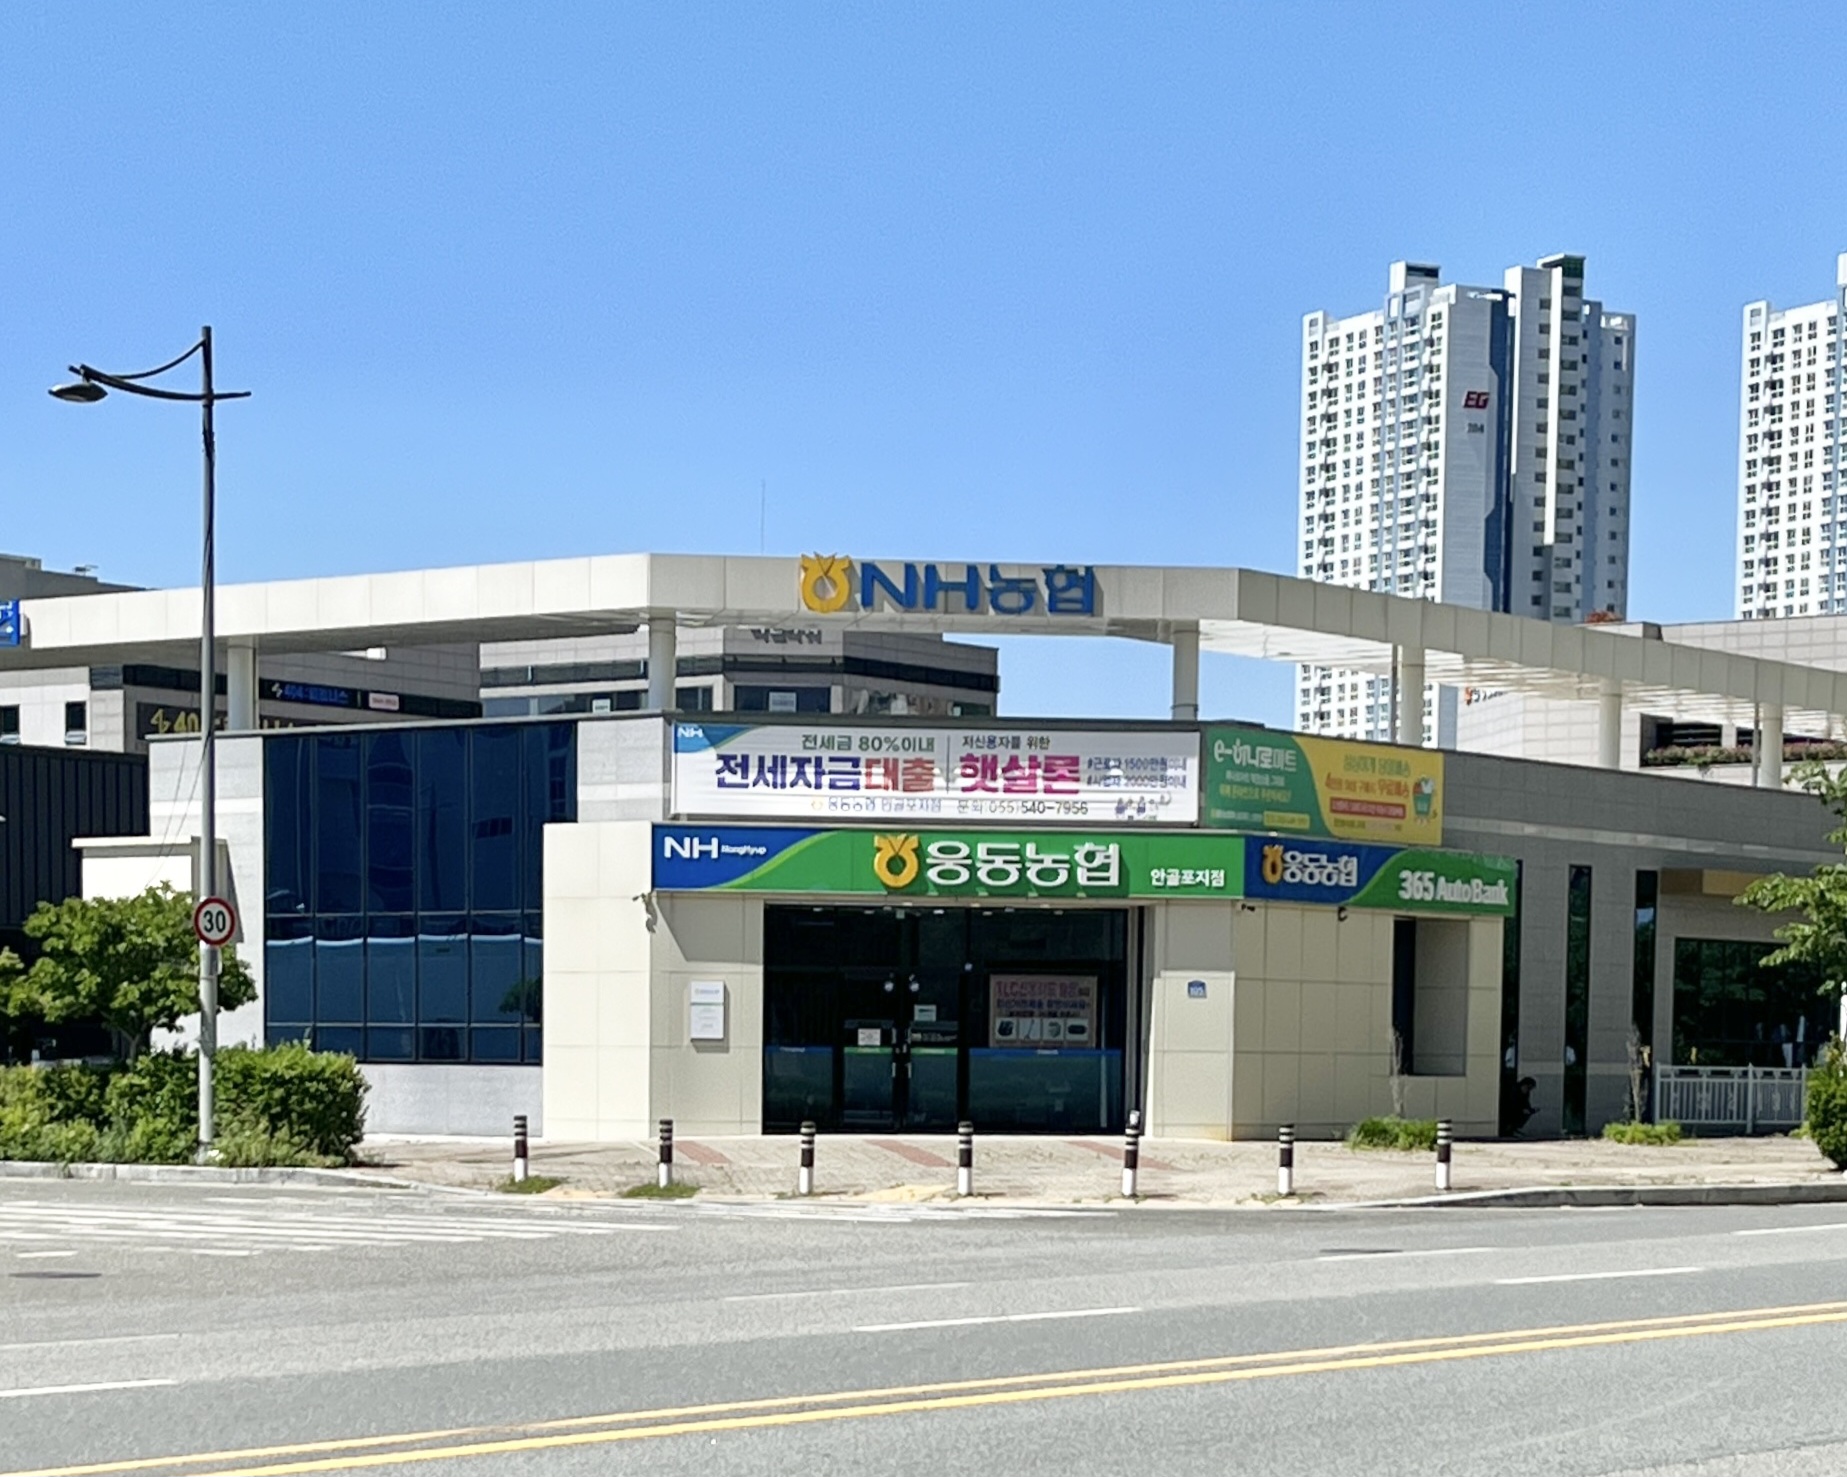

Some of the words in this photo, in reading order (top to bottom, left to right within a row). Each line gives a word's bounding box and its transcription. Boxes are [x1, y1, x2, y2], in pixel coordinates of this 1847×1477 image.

[1464, 391, 1490, 409] EG
[677, 726, 704, 739] NH
[802, 734, 852, 751] 전세금
[962, 735, 1021, 751] 저신용자를
[1027, 735, 1050, 751] 위한
[959, 753, 1081, 794] 햇살론
[664, 836, 719, 859] NH
[926, 841, 1119, 886] 웅동농협
[1150, 867, 1225, 888] 안골포지점
[1283, 850, 1358, 886] 웅동농협
[1399, 870, 1435, 901] 365
[203, 910, 226, 933] 30
